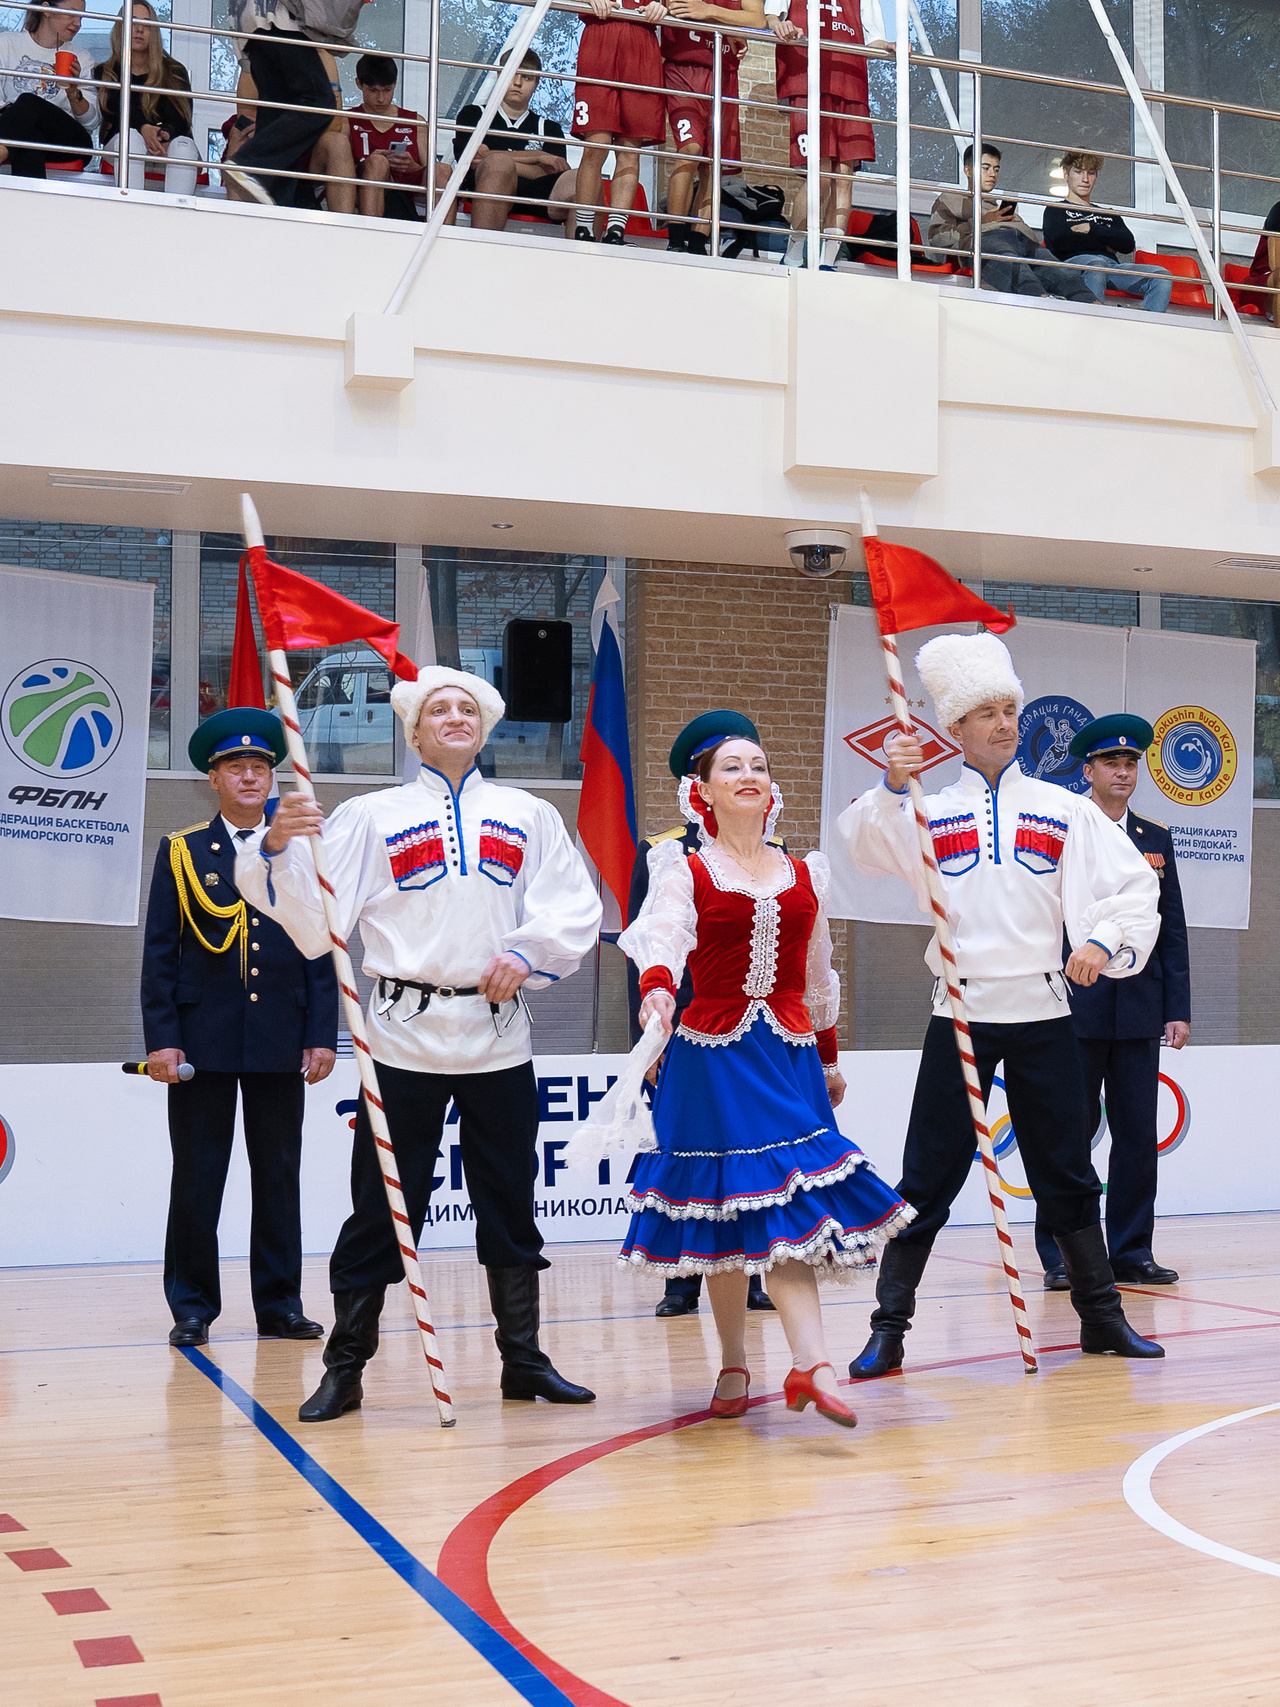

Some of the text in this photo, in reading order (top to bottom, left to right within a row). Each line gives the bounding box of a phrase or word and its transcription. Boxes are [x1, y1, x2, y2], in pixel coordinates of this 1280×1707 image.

[832, 21, 855, 36] group
[576, 101, 589, 125] 3
[677, 119, 693, 142] 2
[360, 132, 370, 155] 1
[1198, 711, 1221, 733] Budo
[1153, 768, 1231, 802] Applied Karate
[0, 812, 130, 834] ДЕРАЦИЯ БАСКЕТБОЛА
[1169, 826, 1238, 838] ЕРАЦИЯ КАРАТЭ
[0, 827, 114, 846] ПРИМОРСКОГО КРАЯ
[1192, 839, 1232, 850] БУДОКАЙ
[1175, 850, 1245, 862] МОРСКОГО КРАЯ
[534, 1197, 632, 1218] НИКОЛА
